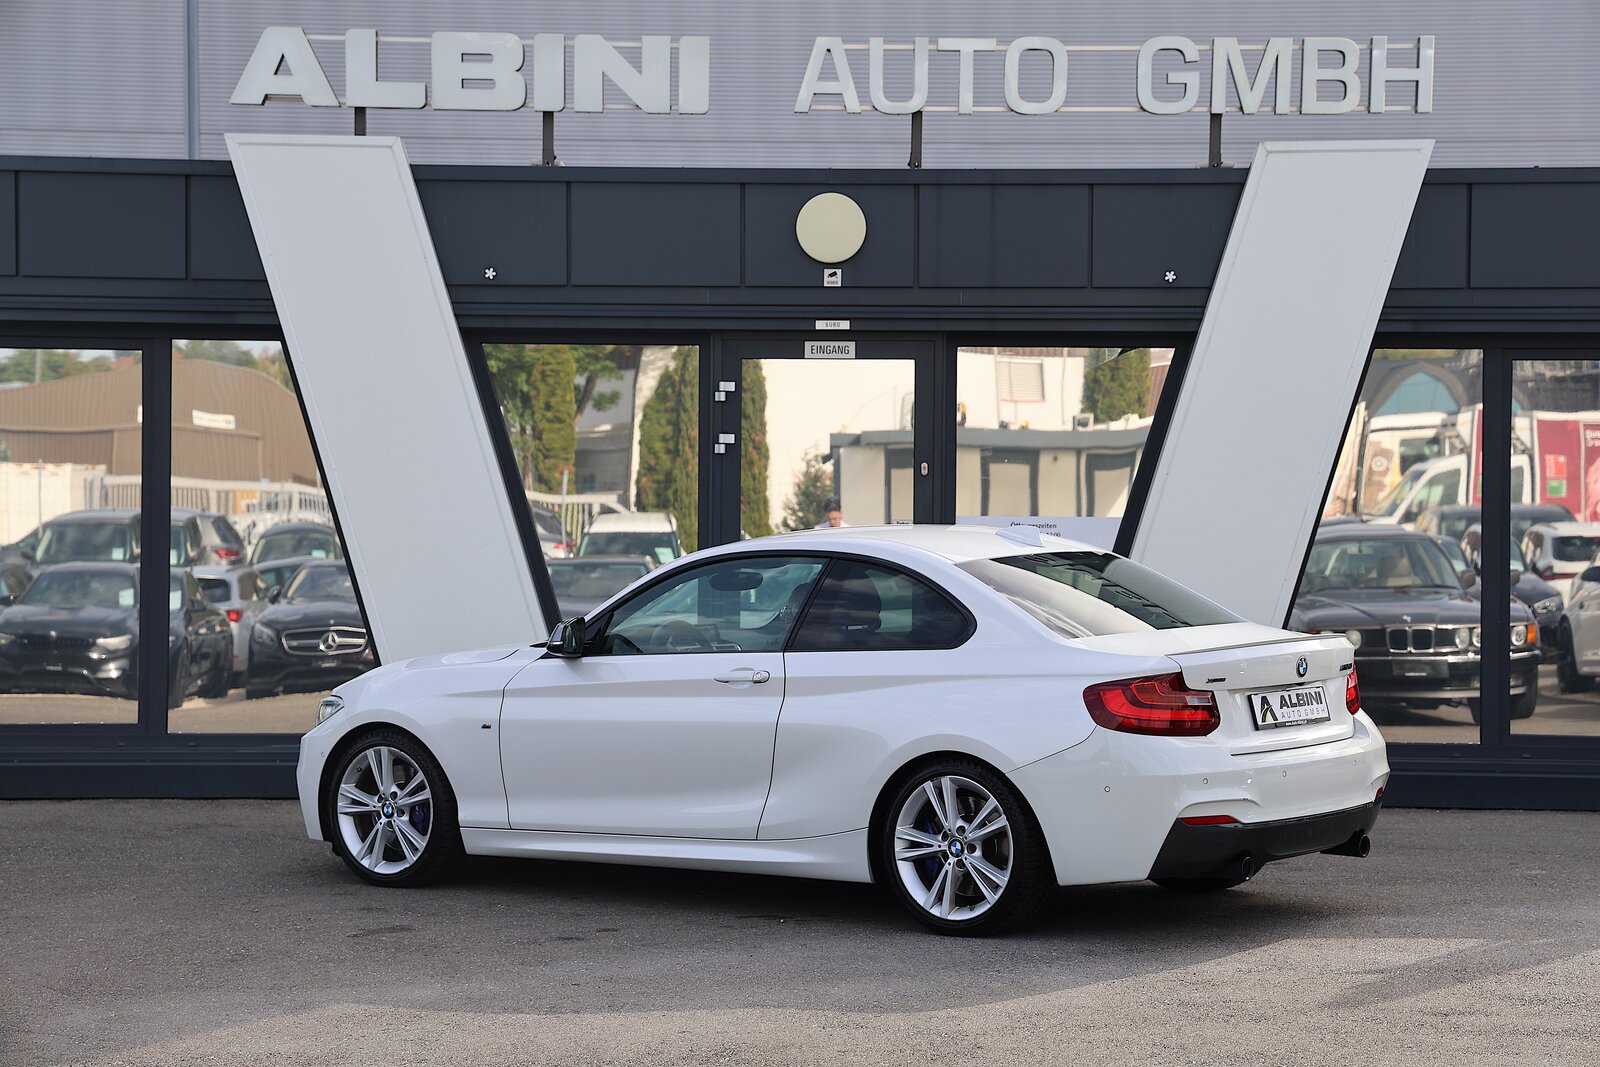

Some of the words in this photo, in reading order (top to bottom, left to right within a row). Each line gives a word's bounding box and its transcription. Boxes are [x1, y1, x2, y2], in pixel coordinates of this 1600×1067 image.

[230, 26, 710, 114] ALBINI
[794, 36, 1069, 114] AUTO
[1136, 35, 1435, 115] GMBH
[810, 344, 850, 355] EINGANG
[1280, 691, 1323, 709] ALBINI
[1281, 709, 1302, 719] AUTO
[1304, 707, 1326, 717] GMBH
